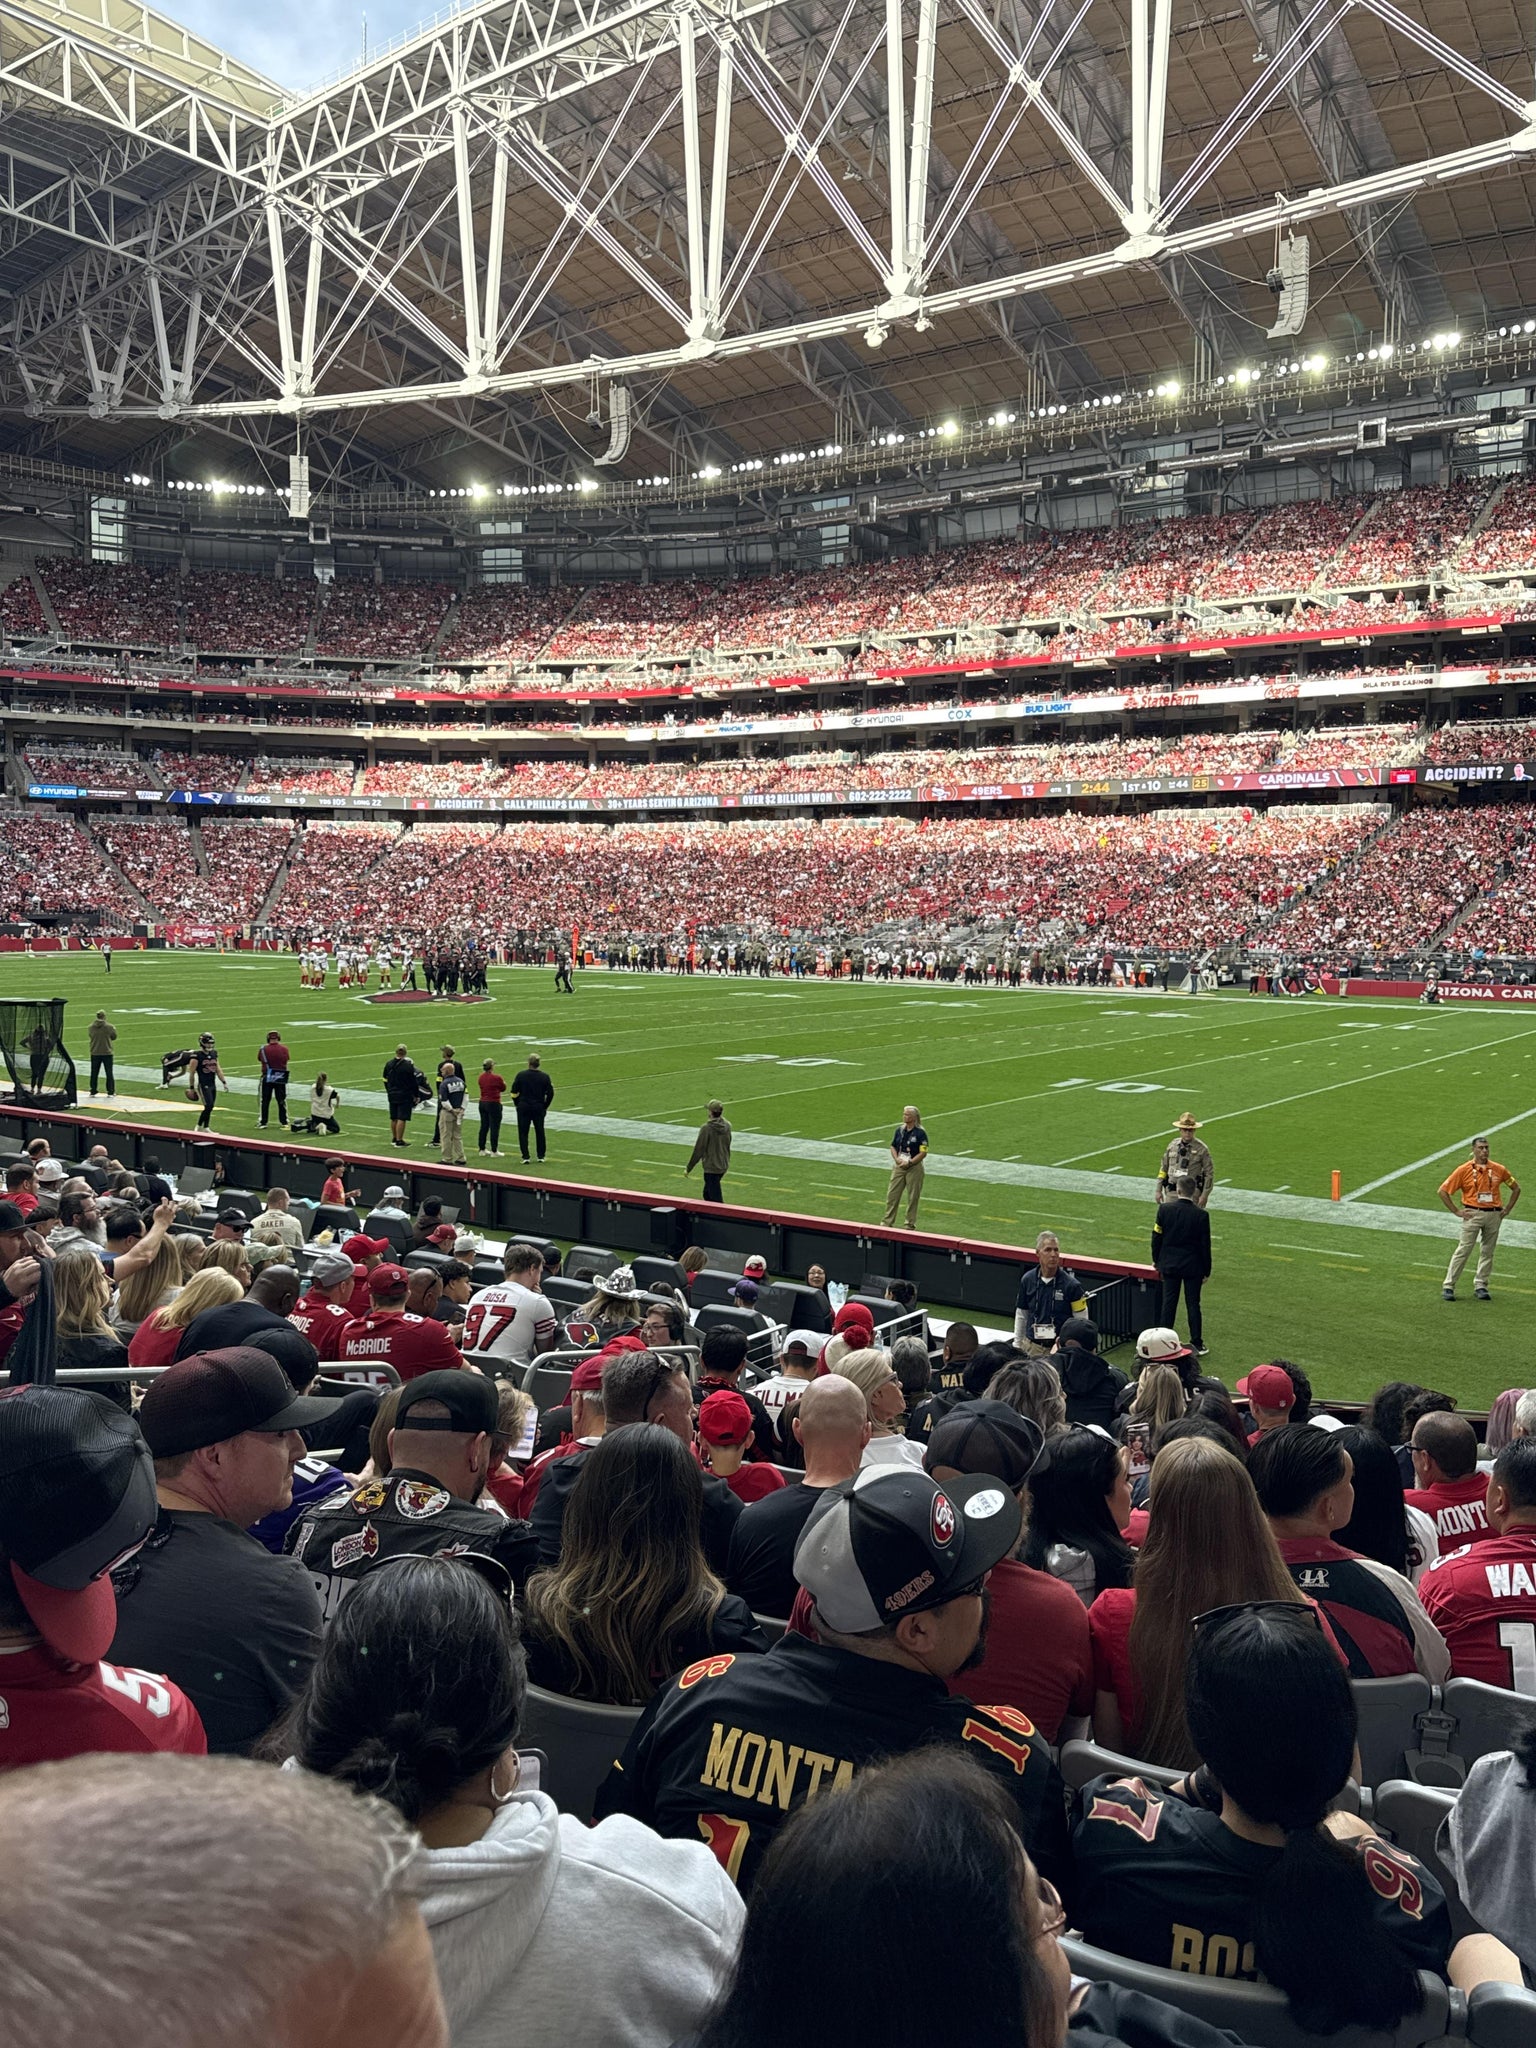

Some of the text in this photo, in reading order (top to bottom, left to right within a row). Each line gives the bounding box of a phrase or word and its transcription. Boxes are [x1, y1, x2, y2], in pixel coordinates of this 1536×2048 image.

[1080, 650, 1116, 659] TILLMAN
[127, 679, 160, 688] MATSON
[1025, 703, 1072, 713] BUD LIGHT
[867, 715, 904, 725] HYUNDAI
[948, 710, 972, 720] COX
[1425, 766, 1504, 781] ACCIDENT?
[1233, 772, 1331, 788] 7 CARDINALS
[43, 786, 77, 796] HYUNDAI
[971, 785, 1003, 796] 49ERS
[1021, 785, 1035, 796] 13
[1081, 782, 1111, 794] 2:44
[1147, 780, 1161, 791] 10
[1194, 779, 1208, 788] 25
[372, 799, 382, 807] 22
[434, 799, 484, 809] ACCIDENT?
[504, 800, 526, 809] CALL
[527, 800, 567, 809] PHILLIPS
[569, 800, 588, 810] LAW
[623, 799, 647, 809] YEARS
[649, 798, 682, 808] SERVING
[683, 797, 718, 807] ARIZONA
[742, 795, 764, 805] OVER
[777, 793, 810, 804] BILLION
[812, 792, 832, 802] WON
[849, 789, 912, 801] 602-222-2222
[1438, 986, 1536, 999] RIZONA CAR
[261, 1220, 285, 1228] BAKER
[483, 1292, 508, 1304] BOSA
[462, 1304, 517, 1352] 97
[346, 1337, 393, 1356] McBRIDE
[334, 1540, 362, 1554] LONDON
[1484, 1562, 1536, 1598] WA
[884, 1570, 936, 1612] 49ERS
